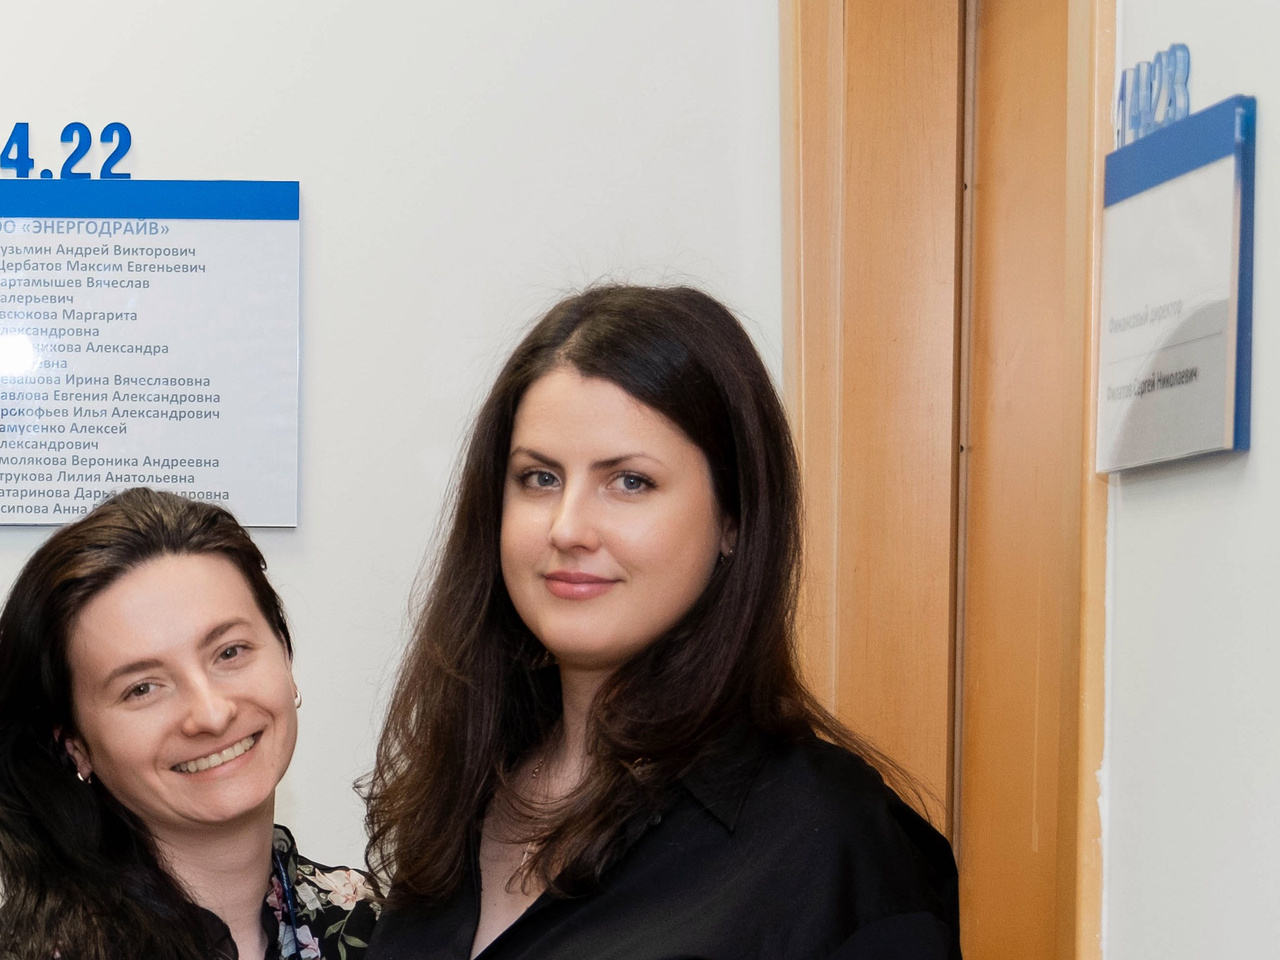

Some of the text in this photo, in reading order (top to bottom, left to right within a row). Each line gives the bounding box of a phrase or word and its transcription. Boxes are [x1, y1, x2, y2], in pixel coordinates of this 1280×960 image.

[22, 219, 170, 237] «ЭНЕРГОДРАЙВ»
[56, 243, 109, 257] Андрей
[114, 244, 196, 258] Викторович
[67, 260, 123, 272] Максим
[127, 261, 206, 273] Евгеньевич
[87, 276, 150, 289] Вячеслав
[63, 308, 137, 322] Маргарита
[86, 341, 169, 354] Александра
[66, 374, 109, 387] Ирина
[114, 374, 210, 387] Вячеславовна
[54, 389, 108, 402] Евгения
[112, 390, 221, 404] Александровна
[73, 405, 107, 418] Илья
[111, 406, 220, 420] Александрович
[70, 421, 127, 435] Алексей
[72, 454, 138, 468] Вероника
[142, 455, 219, 468] Андреевна
[57, 470, 101, 483] Лилия
[105, 471, 195, 484] Анатольевна
[53, 503, 87, 515] Анна
